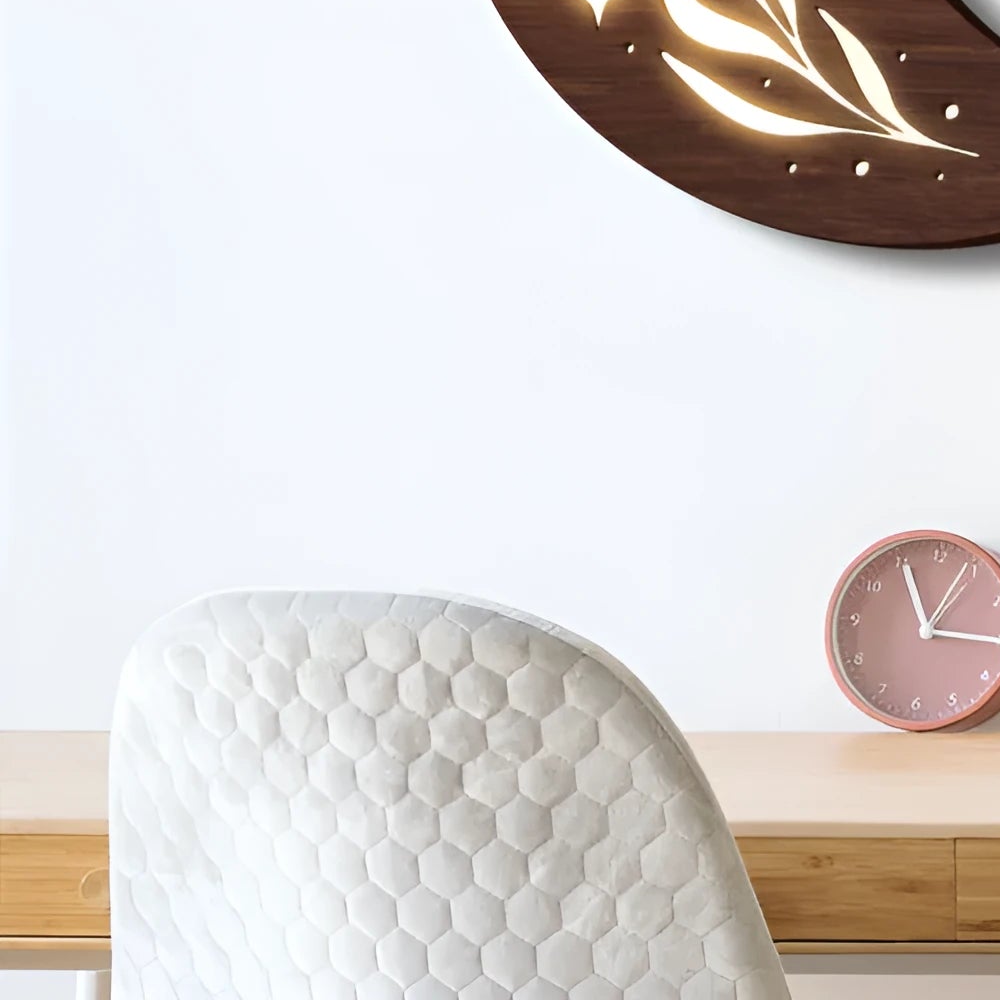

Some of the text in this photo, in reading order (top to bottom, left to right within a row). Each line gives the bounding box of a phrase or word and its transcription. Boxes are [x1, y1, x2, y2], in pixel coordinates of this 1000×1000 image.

[867, 580, 881, 592] 10
[850, 613, 860, 626] 9
[853, 652, 864, 665] 8
[879, 683, 887, 693] 7
[911, 697, 921, 711] 6
[947, 692, 957, 706] 5
